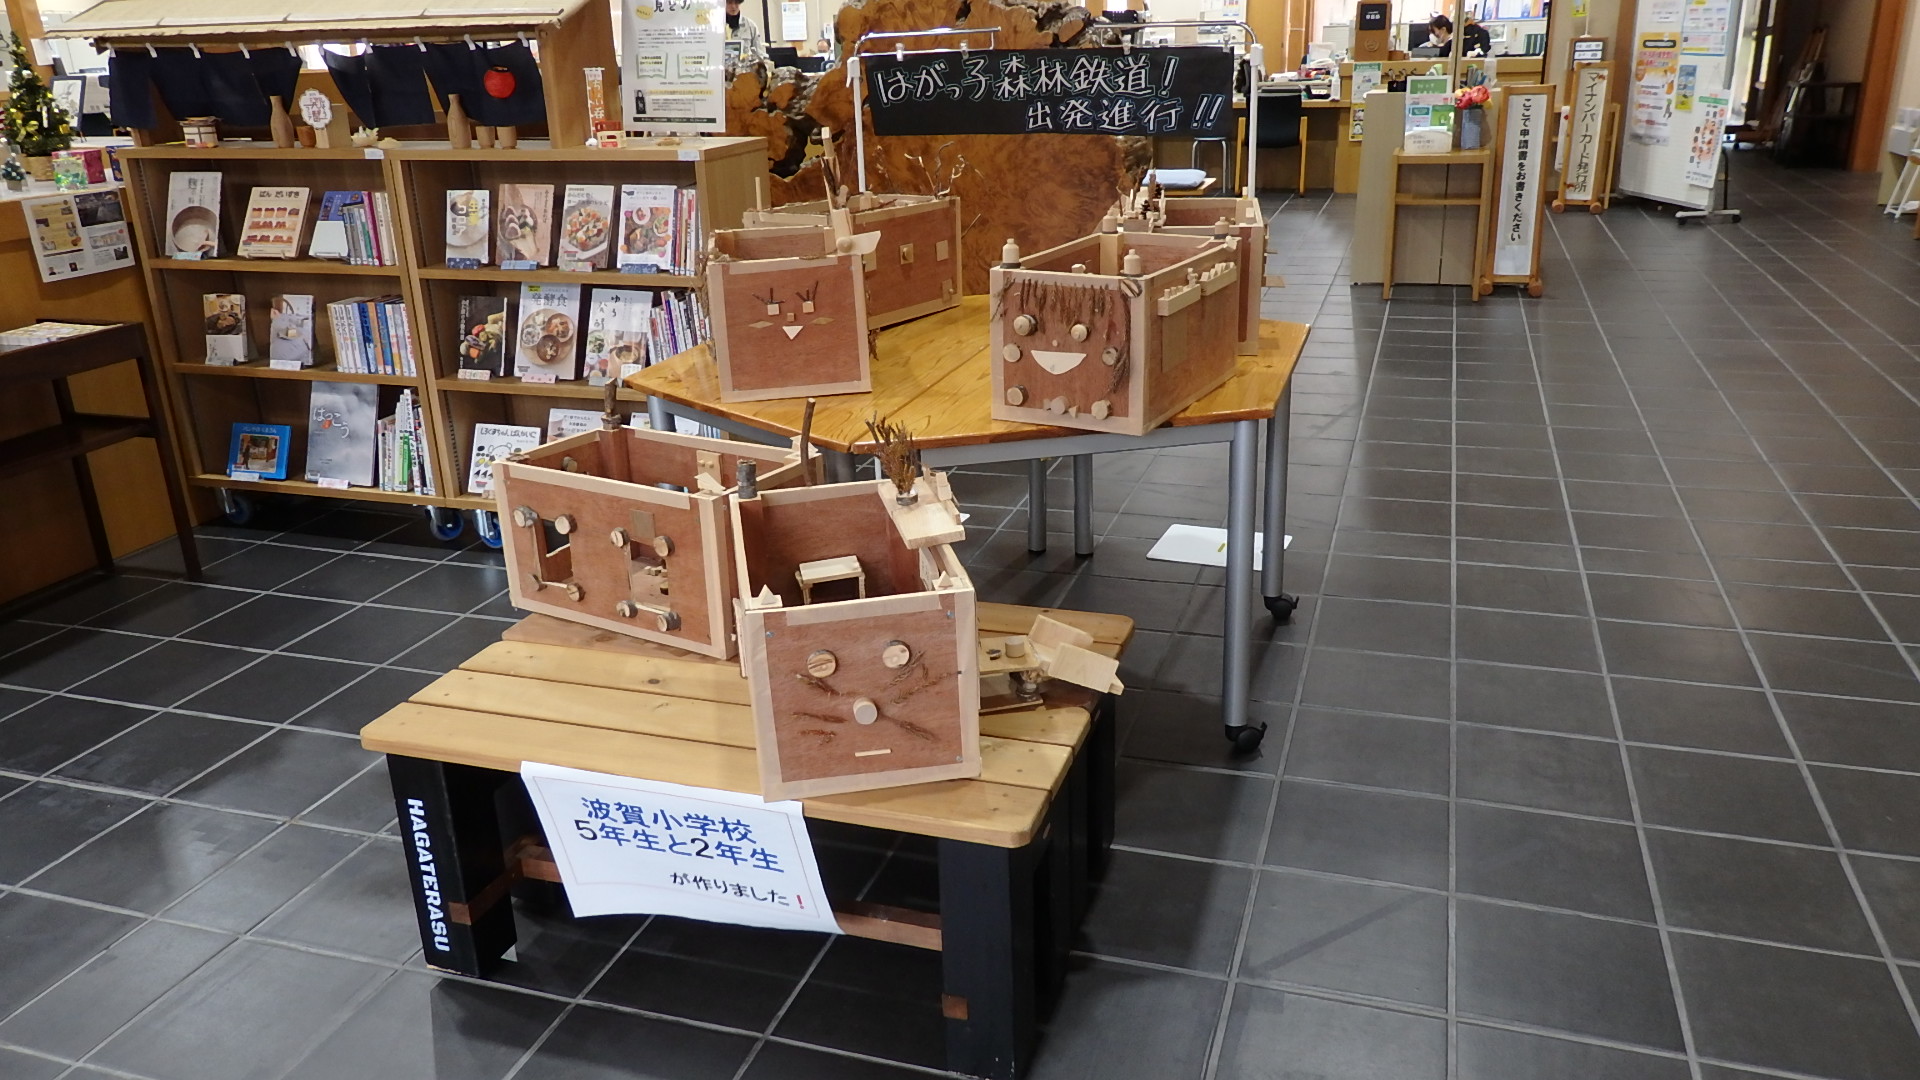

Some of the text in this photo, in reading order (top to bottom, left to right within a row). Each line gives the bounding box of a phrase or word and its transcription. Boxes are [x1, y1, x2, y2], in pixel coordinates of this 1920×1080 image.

[1574, 72, 1600, 193] マイナンバーカード発行所
[1510, 98, 1532, 242] ここで申請書をお書きください
[531, 292, 568, 307] 発酵食
[312, 407, 350, 439] はっこう
[574, 819, 785, 873] 5年生と2年生
[581, 797, 757, 844] 波賀小学校
[407, 798, 451, 952] HAGATERASU
